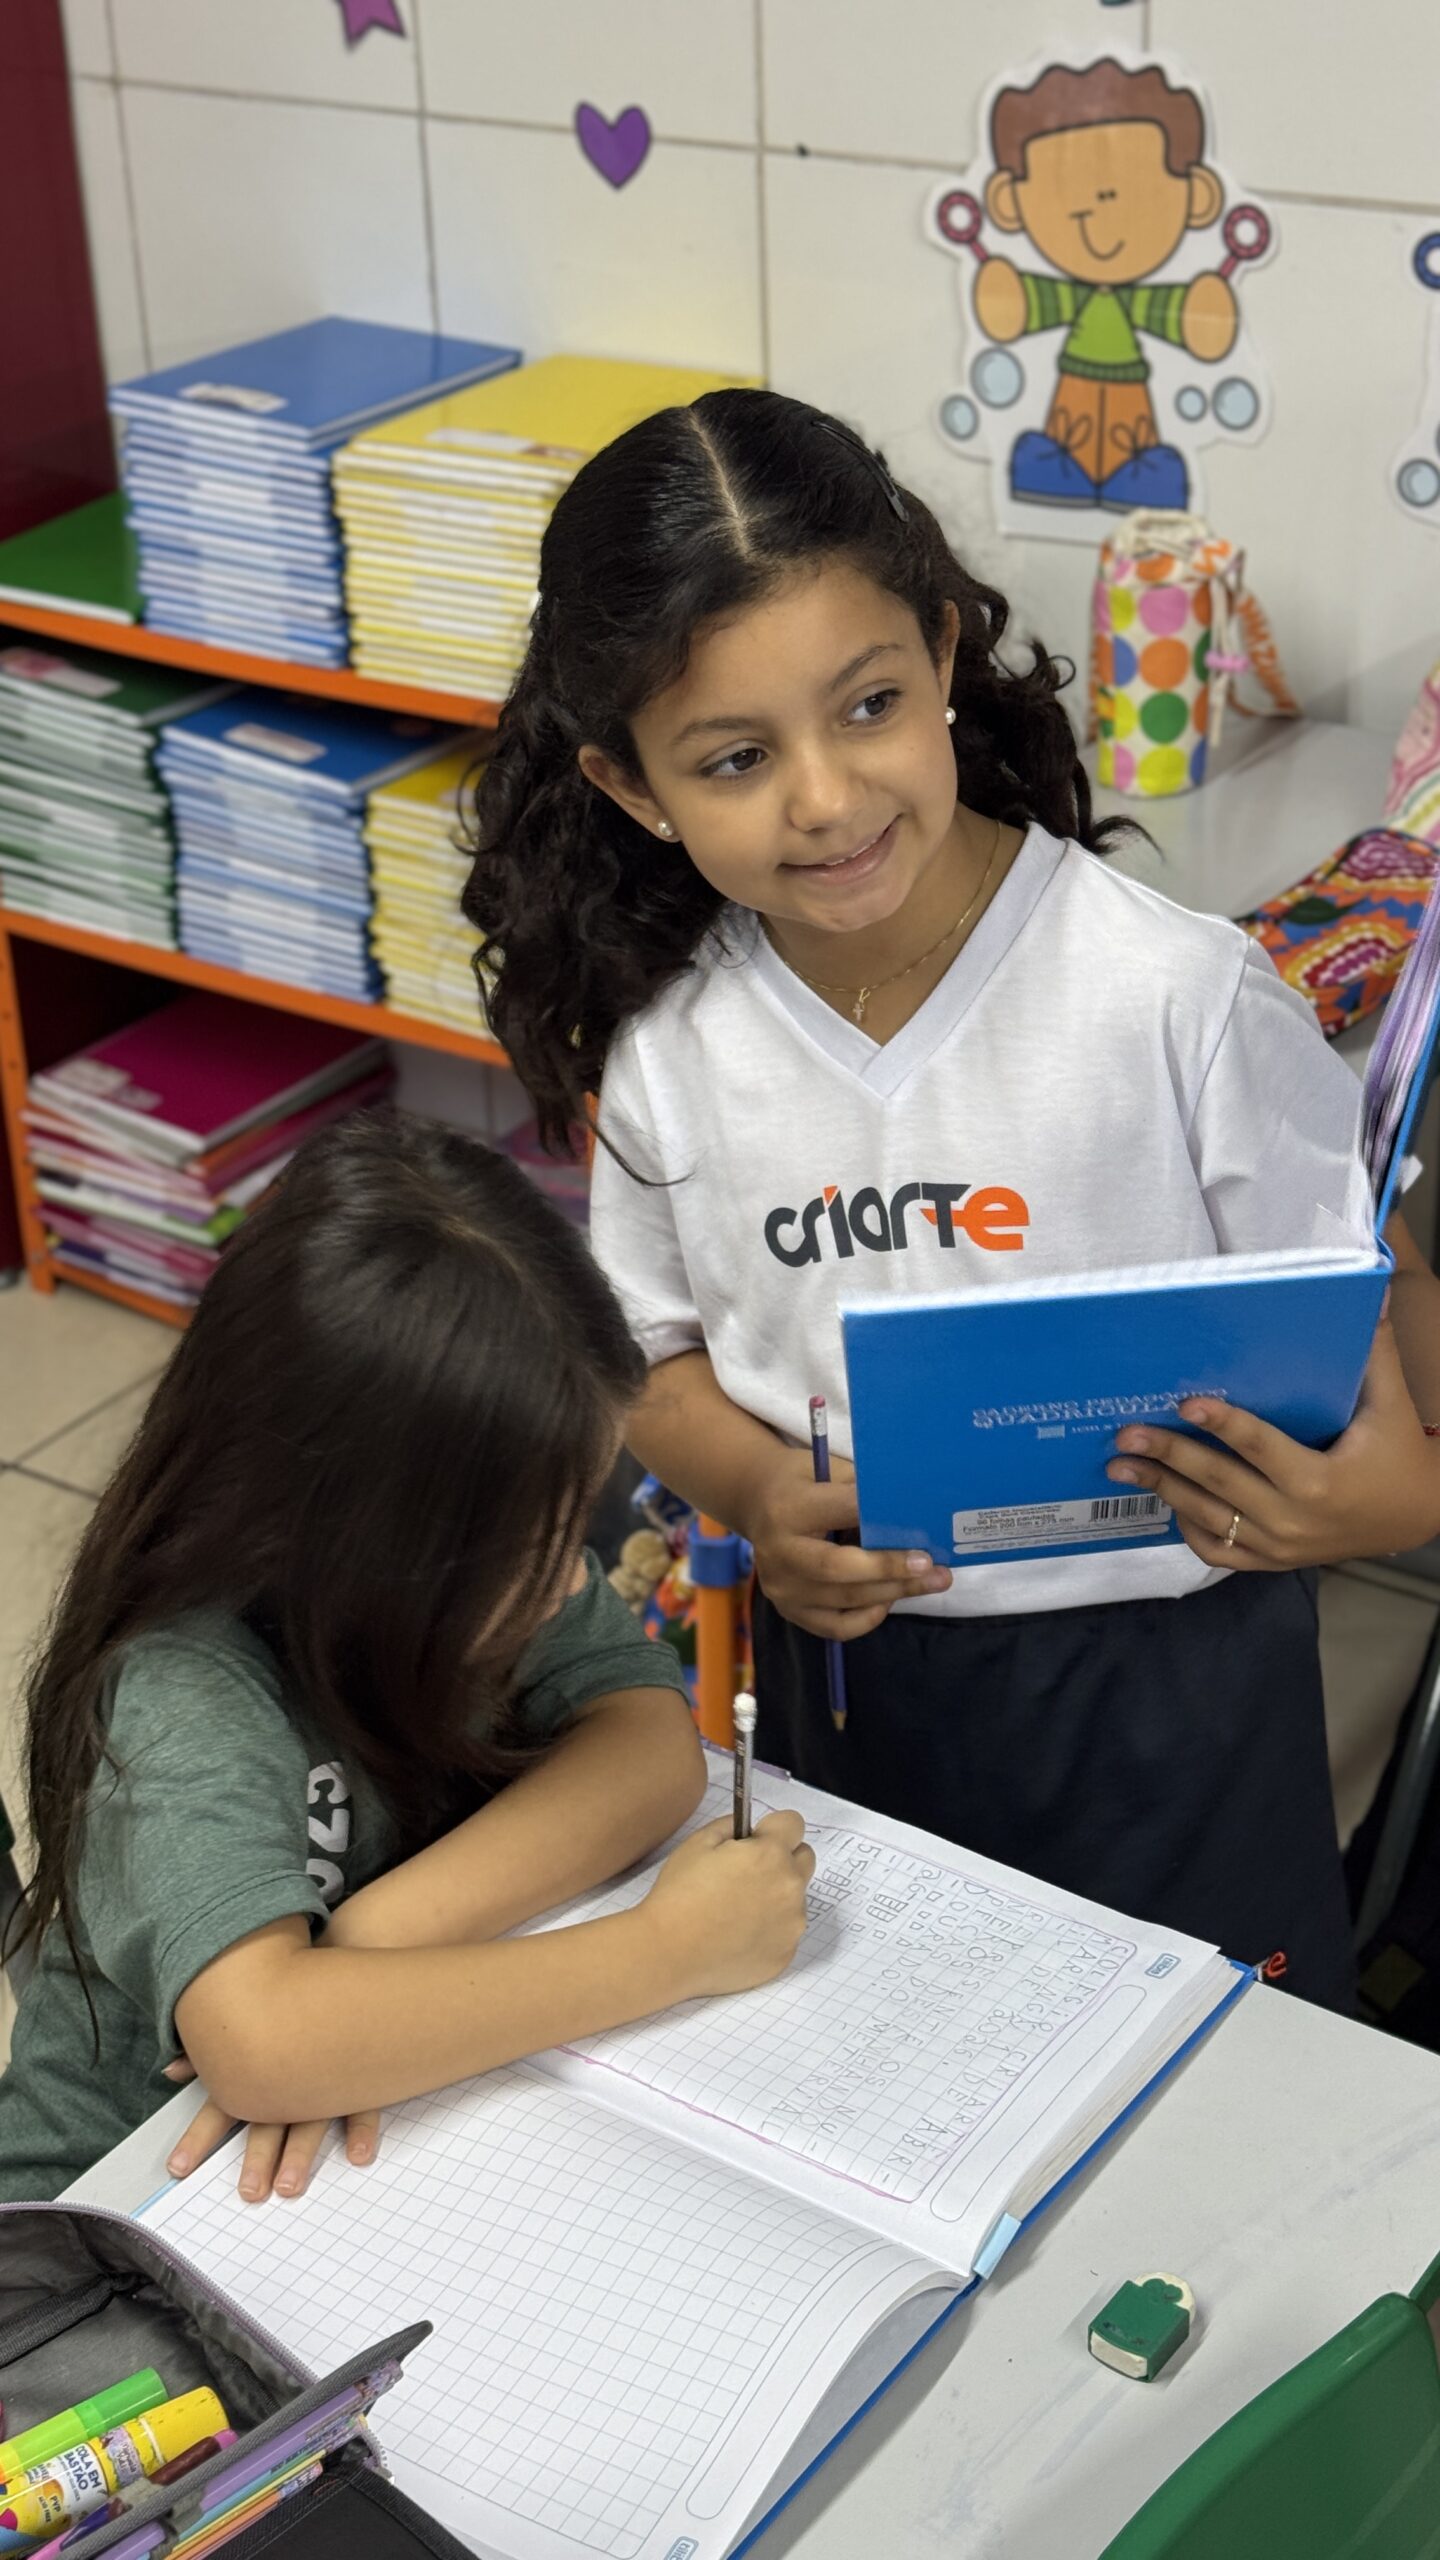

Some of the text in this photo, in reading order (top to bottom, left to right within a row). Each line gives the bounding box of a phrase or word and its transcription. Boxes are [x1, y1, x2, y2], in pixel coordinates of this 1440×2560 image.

[951, 1899, 1026, 1971] MEROS
[888, 1977, 926, 2002] DO
[903, 1911, 1044, 2045] REPRESENTE
[1019, 1966, 1050, 1991] DE
[864, 2058, 901, 2087] OS
[945, 2071, 983, 2102] DE
